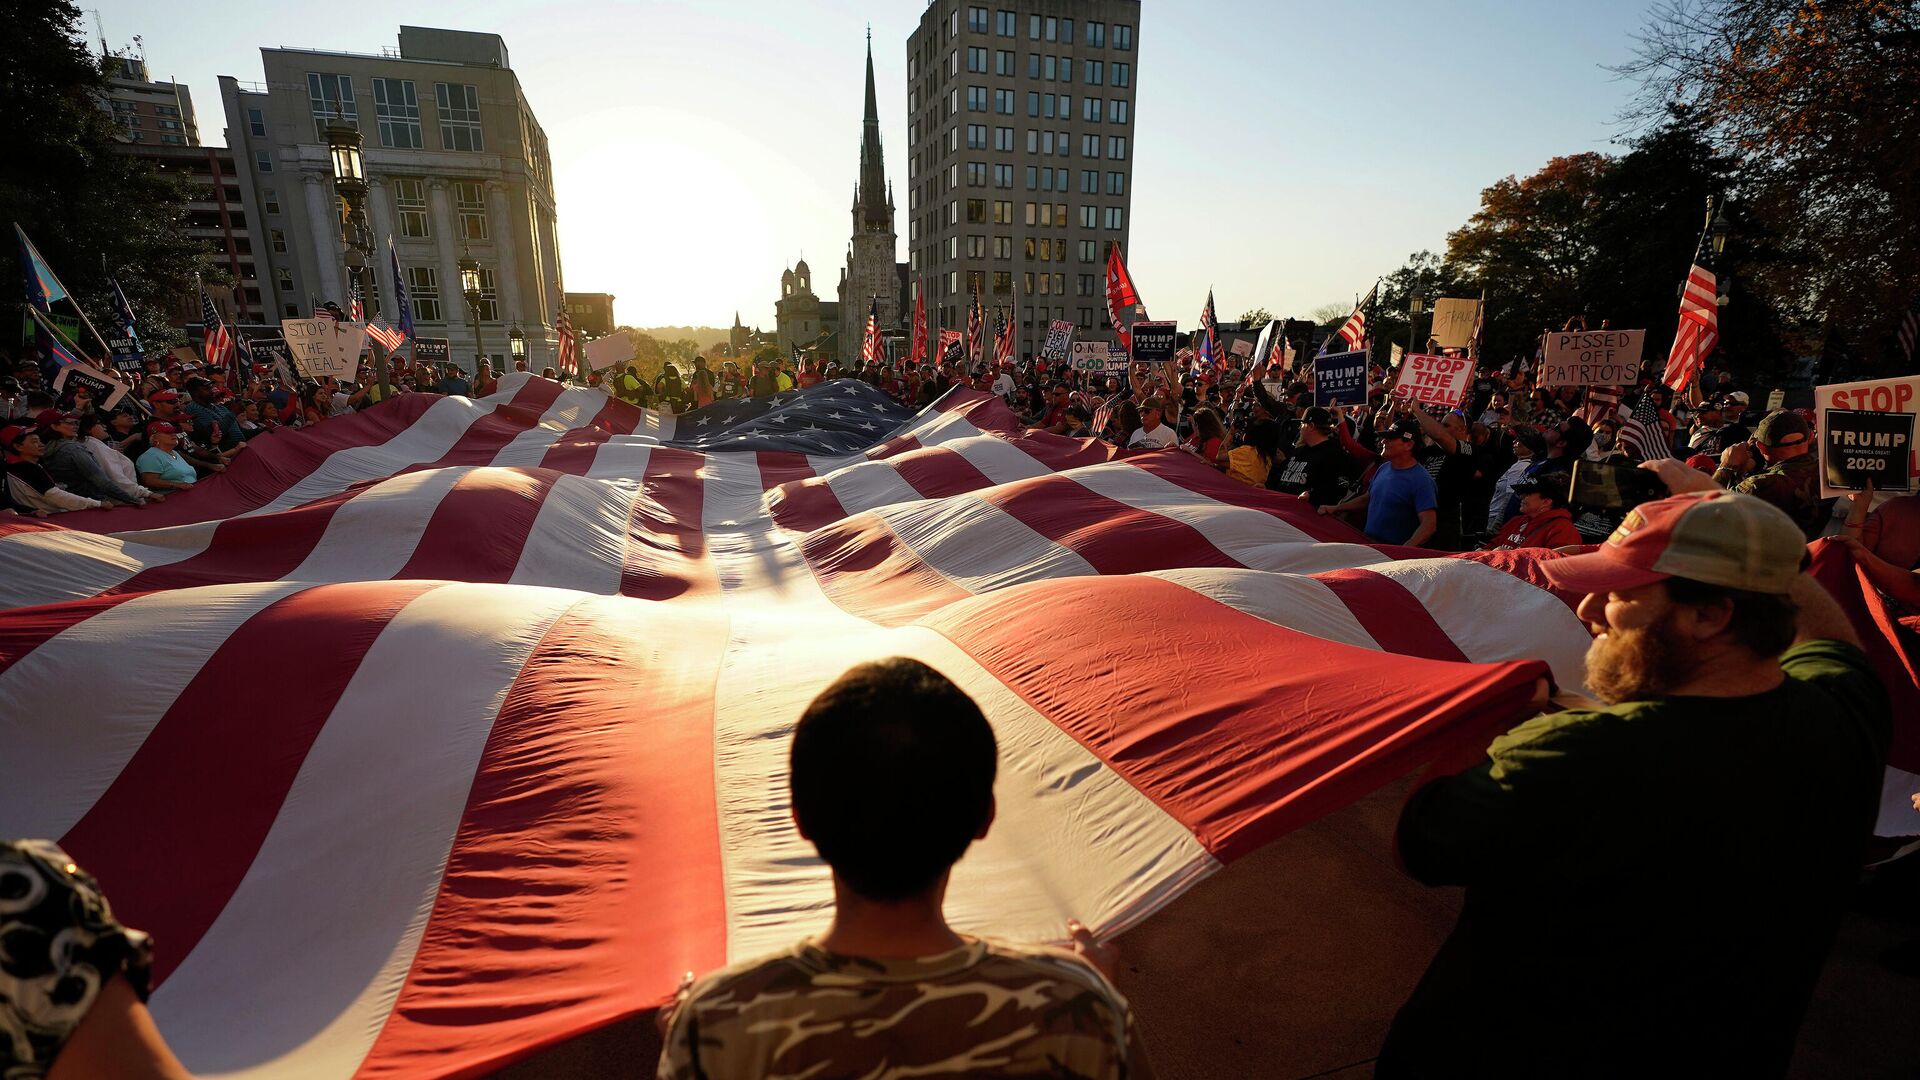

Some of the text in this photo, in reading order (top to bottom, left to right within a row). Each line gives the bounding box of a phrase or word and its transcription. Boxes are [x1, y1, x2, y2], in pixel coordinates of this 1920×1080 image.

[288, 322, 327, 337] STOP
[1051, 320, 1074, 332] COUNT
[110, 339, 134, 348] BACK
[1134, 335, 1174, 343] TRUMP
[1560, 333, 1629, 350] PISSED
[297, 342, 326, 355] THE
[1580, 350, 1615, 362] OFF
[118, 360, 141, 371] BLUE
[295, 357, 343, 372] STEAL
[1076, 358, 1104, 370] GOD
[1107, 362, 1129, 371] UMP
[1411, 357, 1465, 373] STOP
[1317, 365, 1364, 380] TRUMP
[1415, 371, 1453, 388] THE
[1547, 363, 1637, 382] PATRIOTS
[74, 375, 106, 390] TRUMP
[1321, 378, 1360, 388] PENCE
[1395, 384, 1458, 405] STEAL
[1831, 384, 1912, 413] STOP
[1830, 430, 1906, 447] TRUMP
[1846, 457, 1886, 470] 2020
